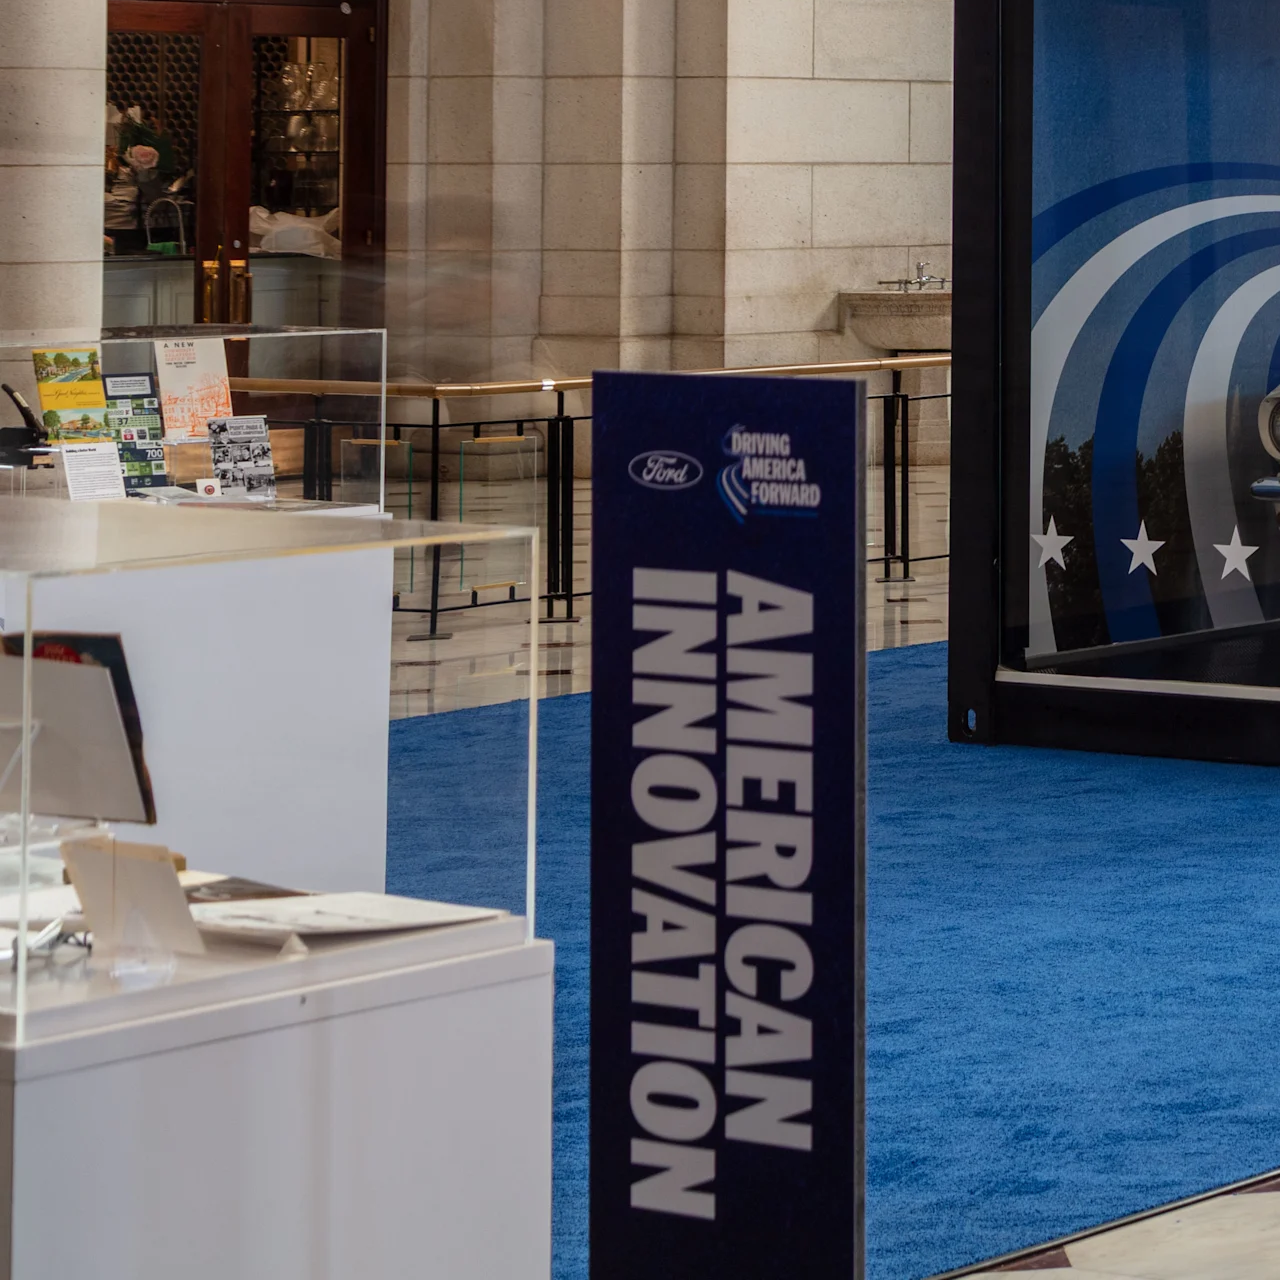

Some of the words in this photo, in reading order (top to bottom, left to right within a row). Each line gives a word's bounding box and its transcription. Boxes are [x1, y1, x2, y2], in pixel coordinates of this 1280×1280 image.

[117, 417, 129, 426] 37
[146, 449, 164, 459] 700
[731, 431, 790, 456] DRIVING
[640, 453, 690, 484] Ford
[742, 456, 806, 481] AMERICA
[750, 481, 821, 507] FORWARD
[724, 569, 814, 1151] AMERICAN
[630, 567, 718, 1220] INNOVATION
